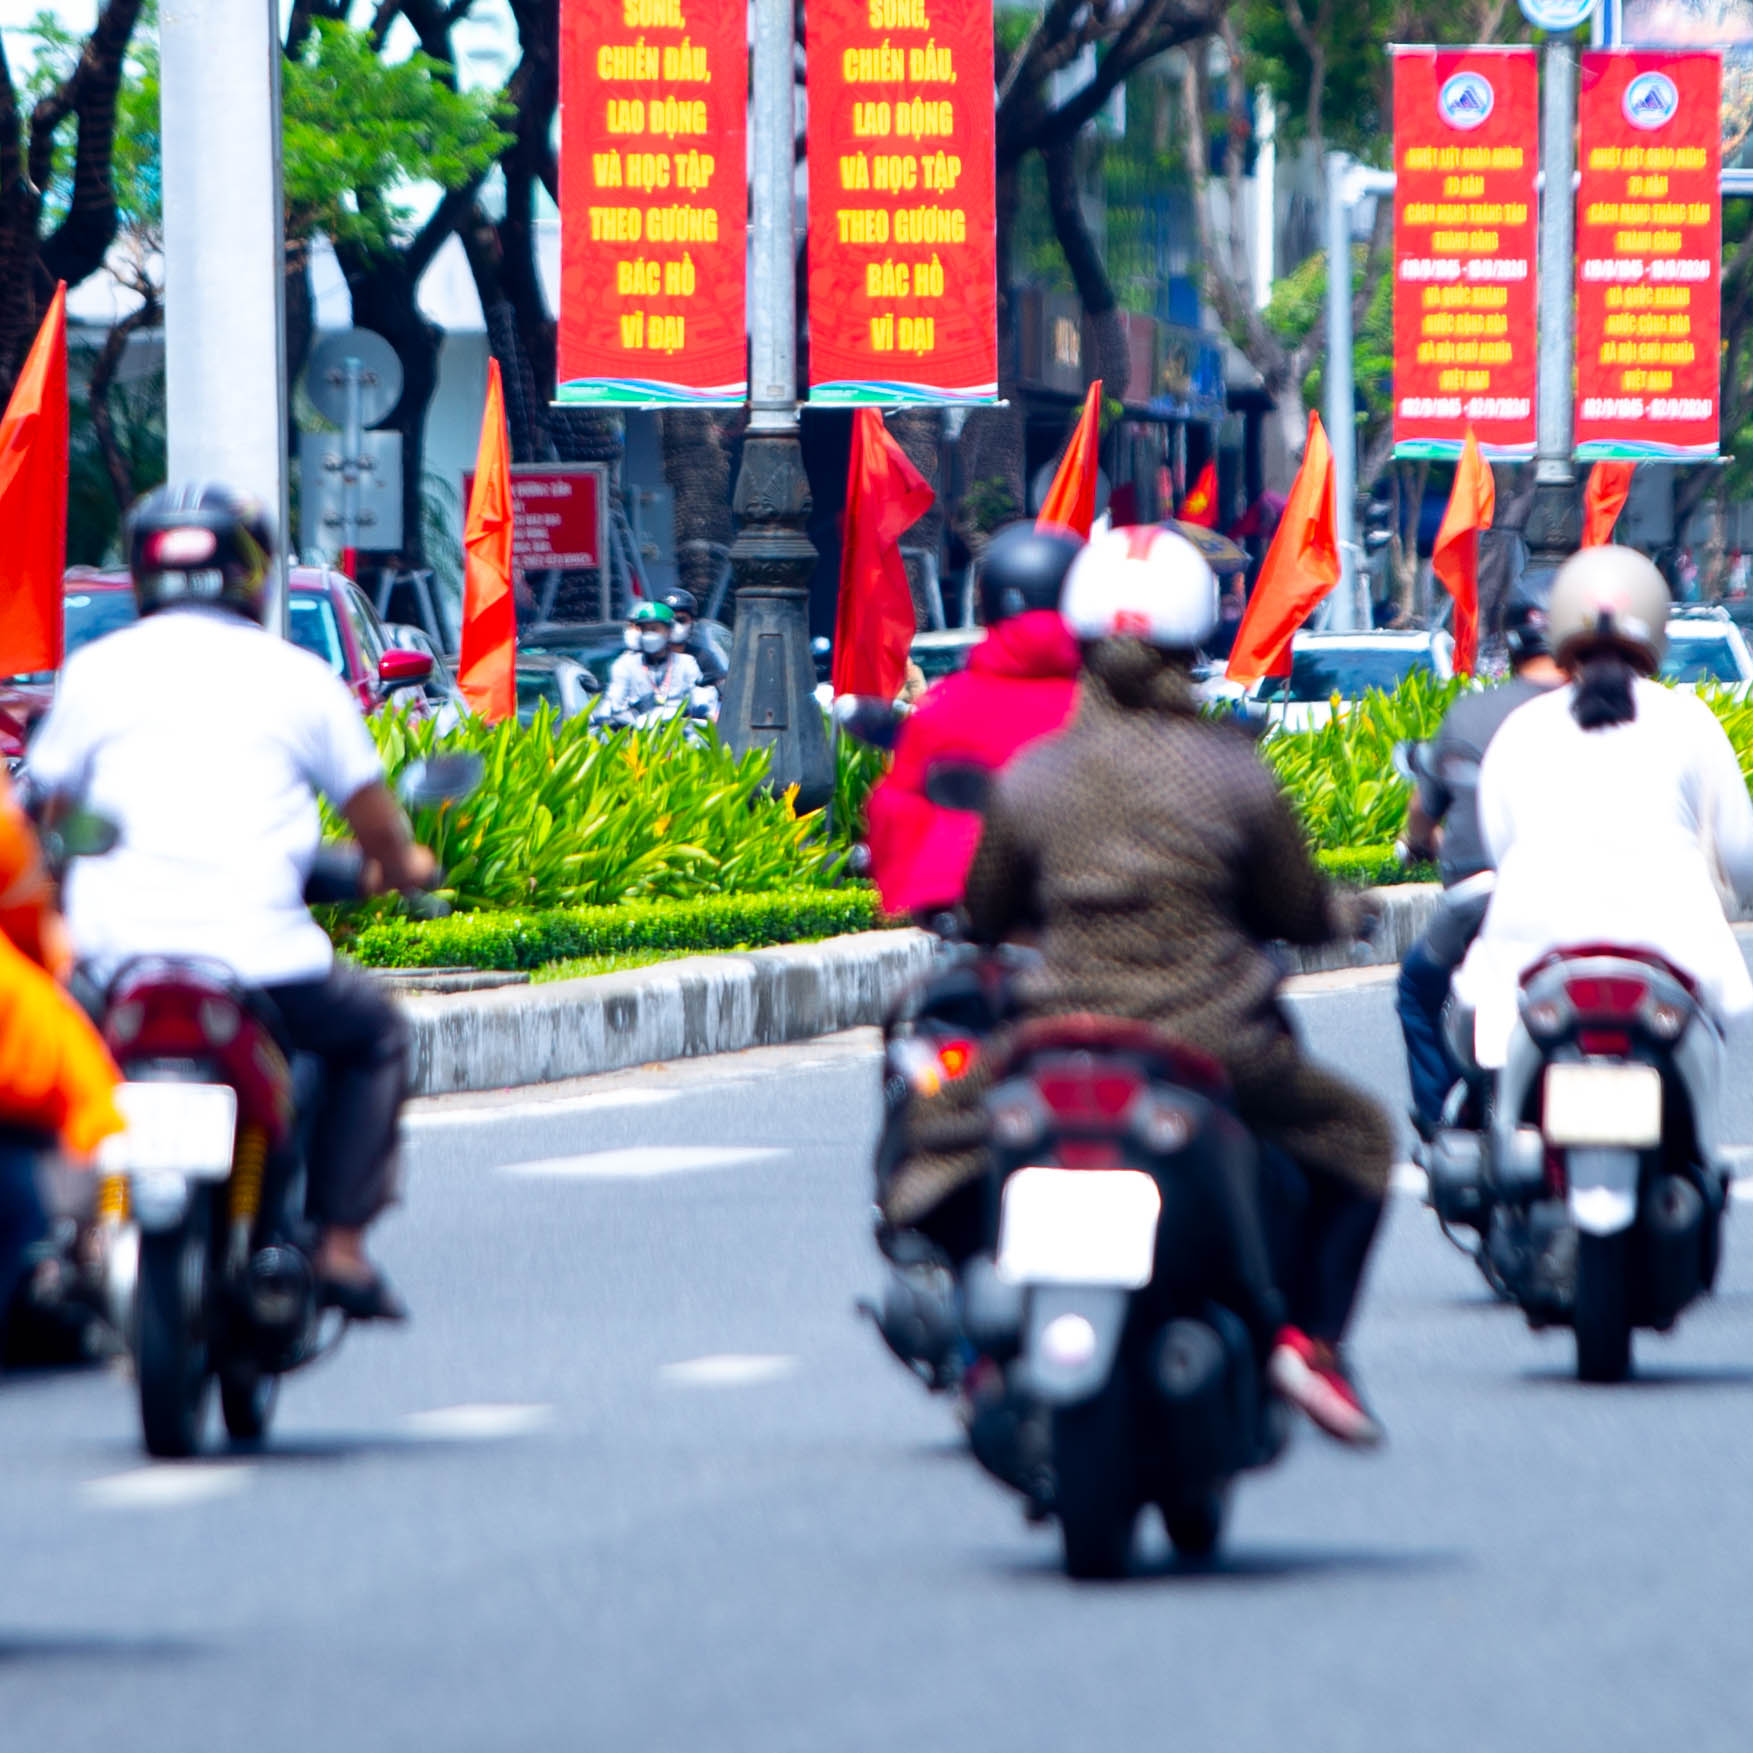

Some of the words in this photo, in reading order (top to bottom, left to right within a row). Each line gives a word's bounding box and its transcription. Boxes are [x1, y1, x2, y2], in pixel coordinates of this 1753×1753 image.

[596, 36, 660, 81] CHIẾN
[842, 38, 905, 83] CHIẾN
[606, 99, 646, 135] LAO
[852, 101, 892, 137] LAO
[592, 149, 623, 188] VÀ
[625, 153, 671, 193] HỌC
[674, 149, 715, 194] TẬP
[839, 151, 870, 190] VÀ
[872, 155, 918, 195] HỌC
[921, 150, 962, 195] TẬP
[589, 207, 642, 242] THEO
[645, 203, 718, 243] GƯƠNG
[836, 209, 890, 244] THEO
[893, 205, 966, 244] GƯƠNG
[616, 256, 661, 296] BÁC
[664, 251, 695, 296] HỒ
[865, 258, 911, 298] BÁC
[913, 253, 945, 297] HỒ
[647, 315, 685, 355] ĐẠI
[897, 317, 935, 357] ĐẠI
